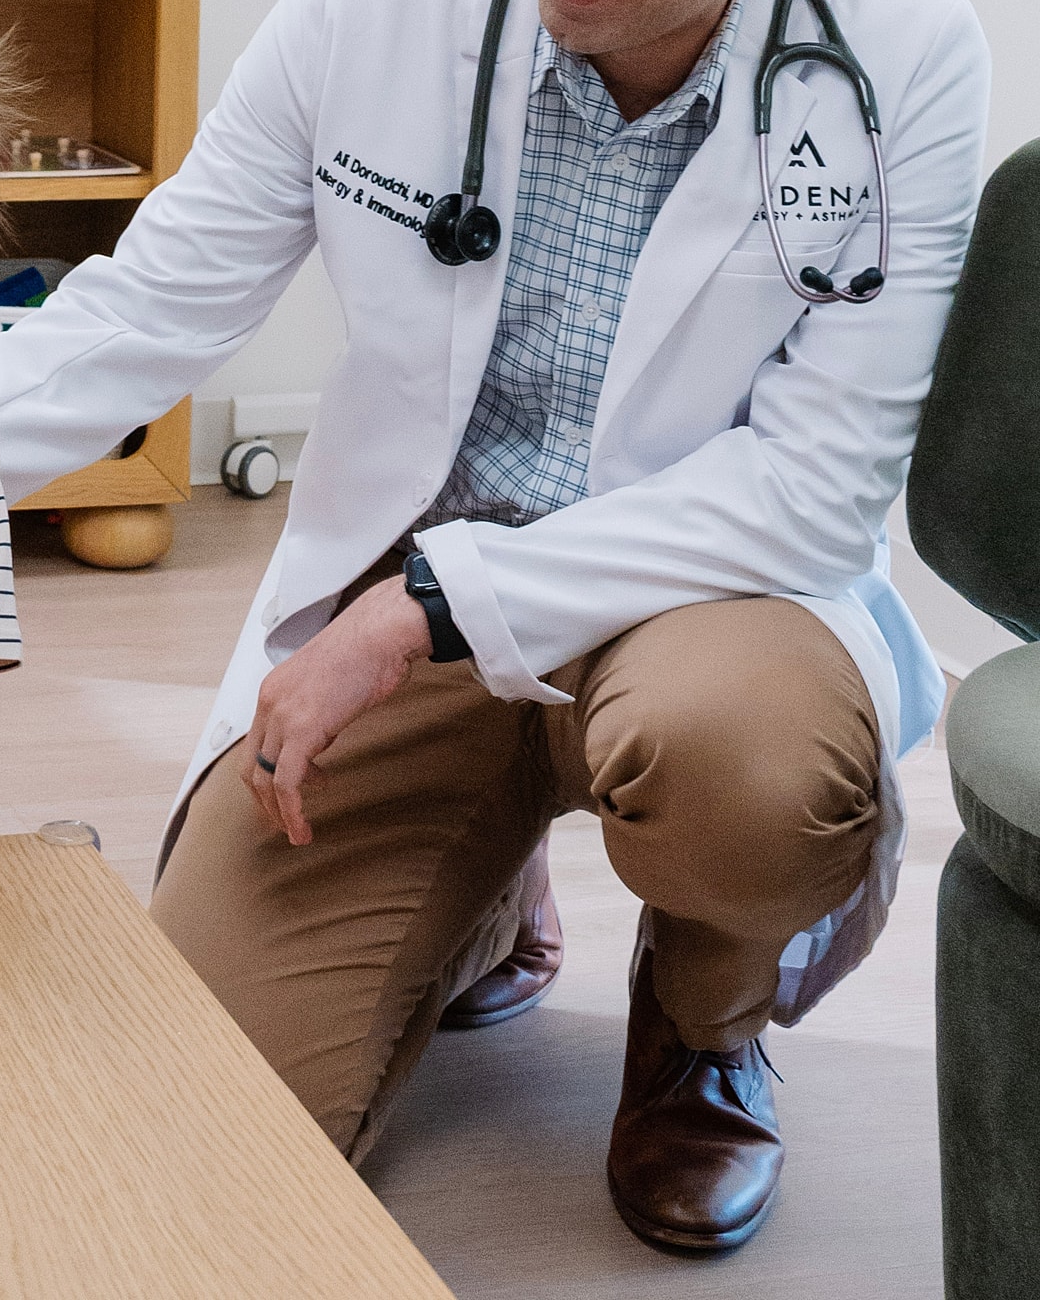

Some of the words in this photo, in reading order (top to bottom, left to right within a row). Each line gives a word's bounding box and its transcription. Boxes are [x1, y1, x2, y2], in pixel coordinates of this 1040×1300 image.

[315, 165, 352, 200] Allergy
[353, 188, 365, 205] &
[366, 195, 427, 239] Immunolog
[333, 150, 351, 168] Ali
[350, 158, 411, 202] Doroudchi,
[412, 189, 435, 209] MD
[761, 185, 871, 207] DENA
